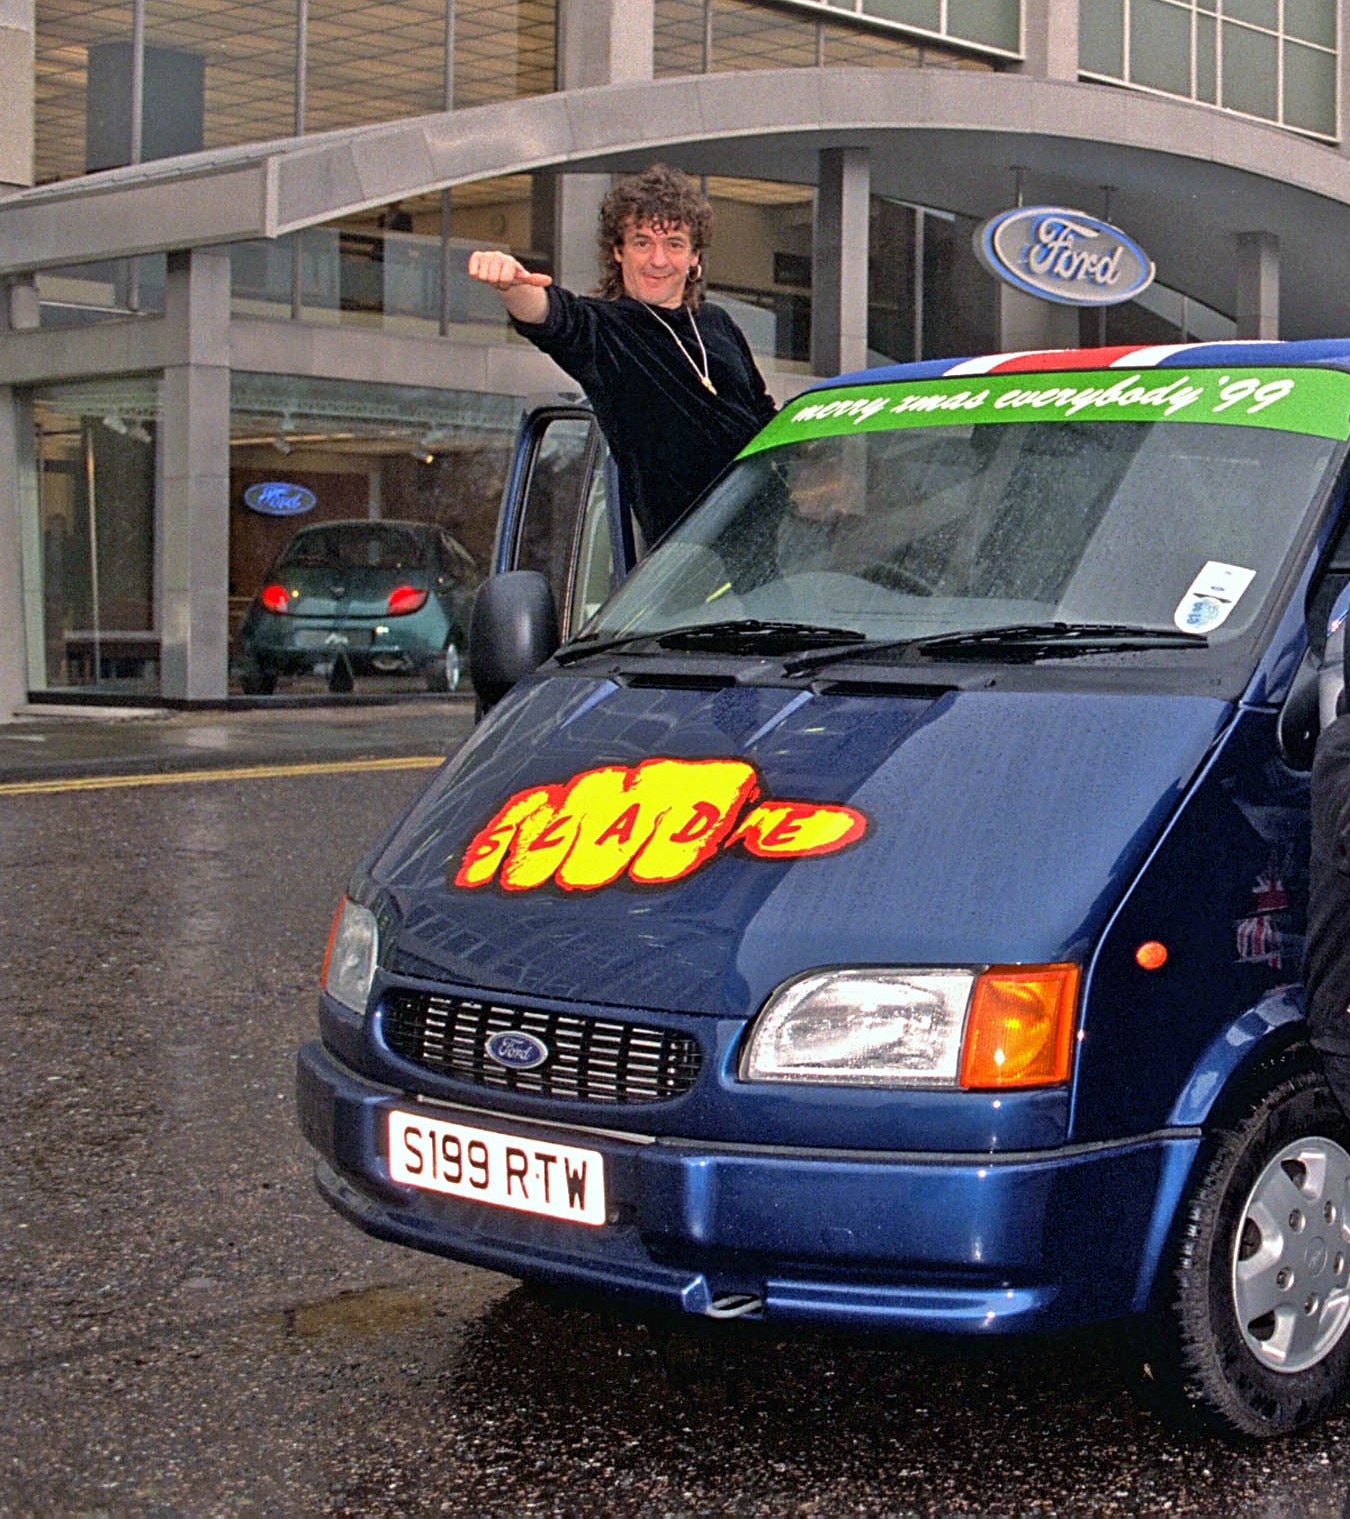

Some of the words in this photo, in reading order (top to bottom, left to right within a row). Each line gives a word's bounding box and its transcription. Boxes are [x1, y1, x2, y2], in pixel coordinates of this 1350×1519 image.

[1029, 216, 1124, 285] Ford
[791, 396, 889, 425] merry
[890, 388, 990, 414] xmas
[994, 374, 1204, 417] everybody
[499, 1037, 533, 1061] Ford
[404, 1126, 489, 1190] S199
[505, 1146, 587, 1211] RTW
